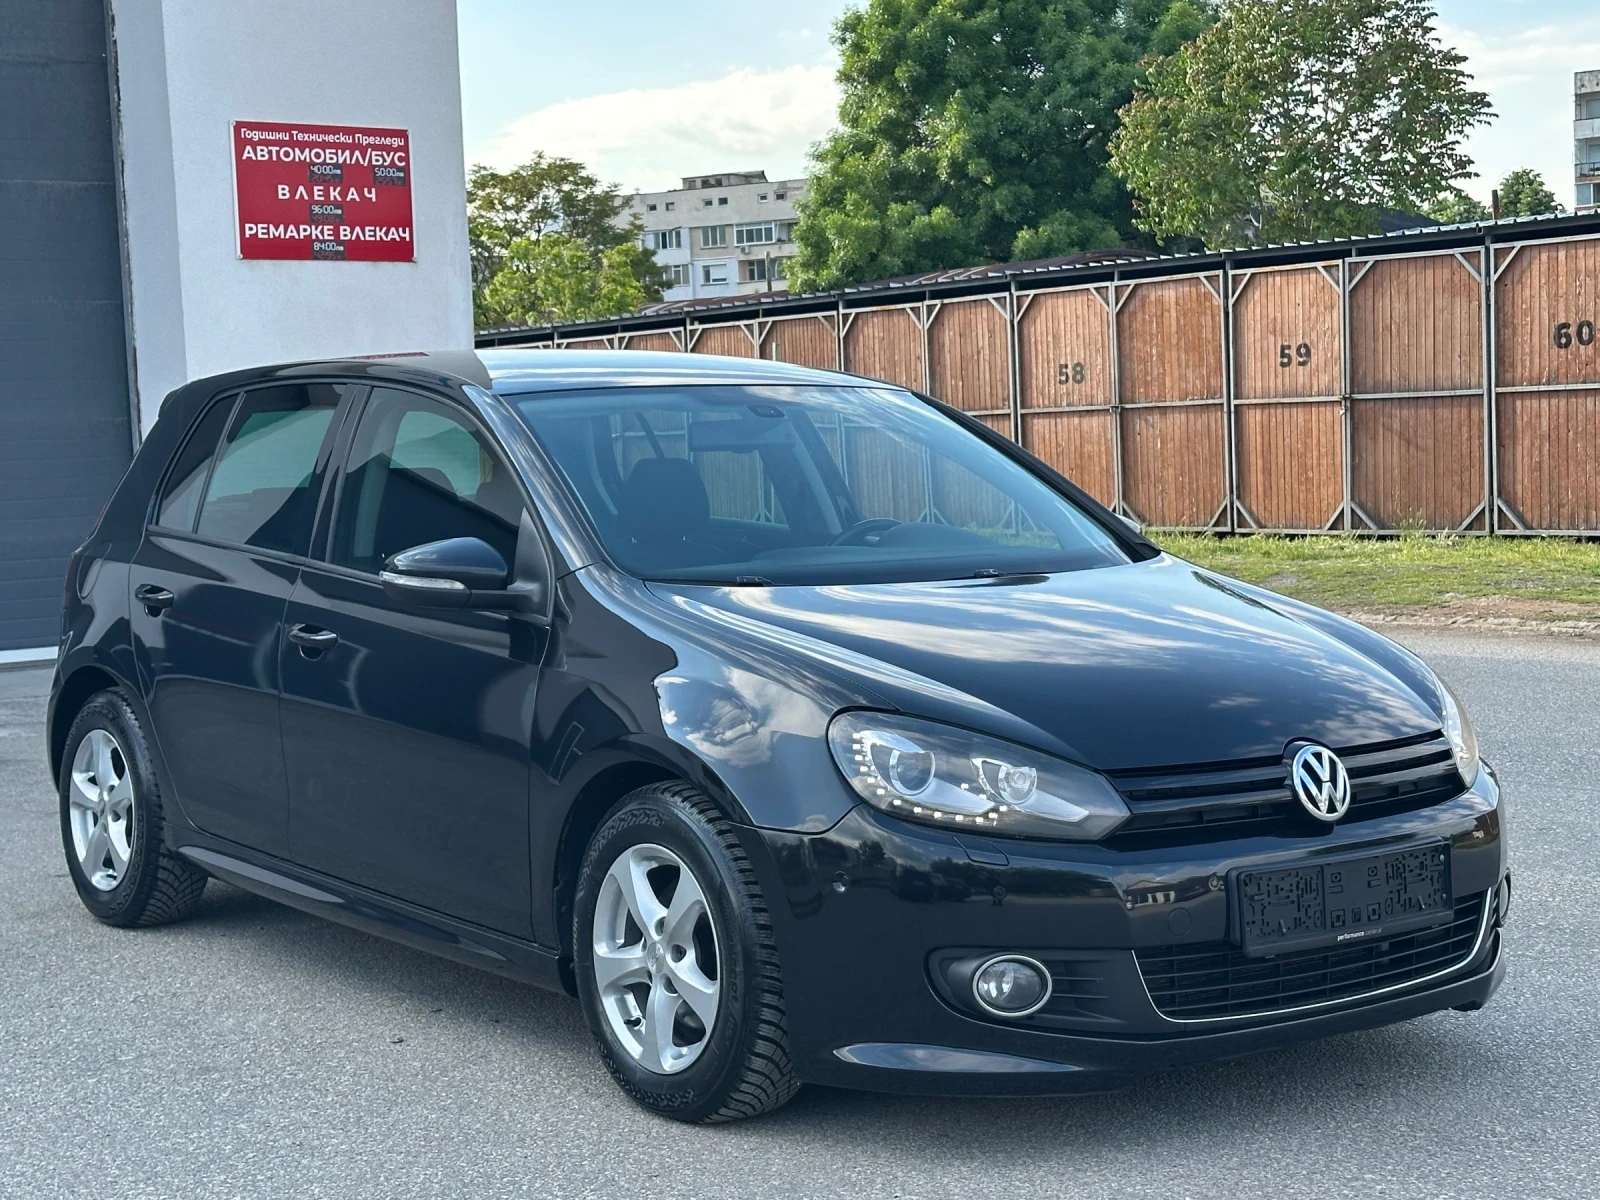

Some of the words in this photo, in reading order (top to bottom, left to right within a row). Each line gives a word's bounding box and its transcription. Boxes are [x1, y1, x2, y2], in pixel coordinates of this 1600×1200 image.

[240, 128, 290, 141] Годишни
[291, 130, 352, 144] Технически
[354, 133, 405, 147] Прегледи
[241, 145, 406, 167] АВТОМОБИЛ/БУС
[277, 184, 377, 202] ВЛЕКАЧ
[244, 223, 335, 241] РЕМАРКЕ
[339, 226, 410, 242] ВЛЕКАЧ
[1553, 319, 1595, 349] 60
[1279, 342, 1311, 368] 59
[1058, 361, 1085, 385] 58
